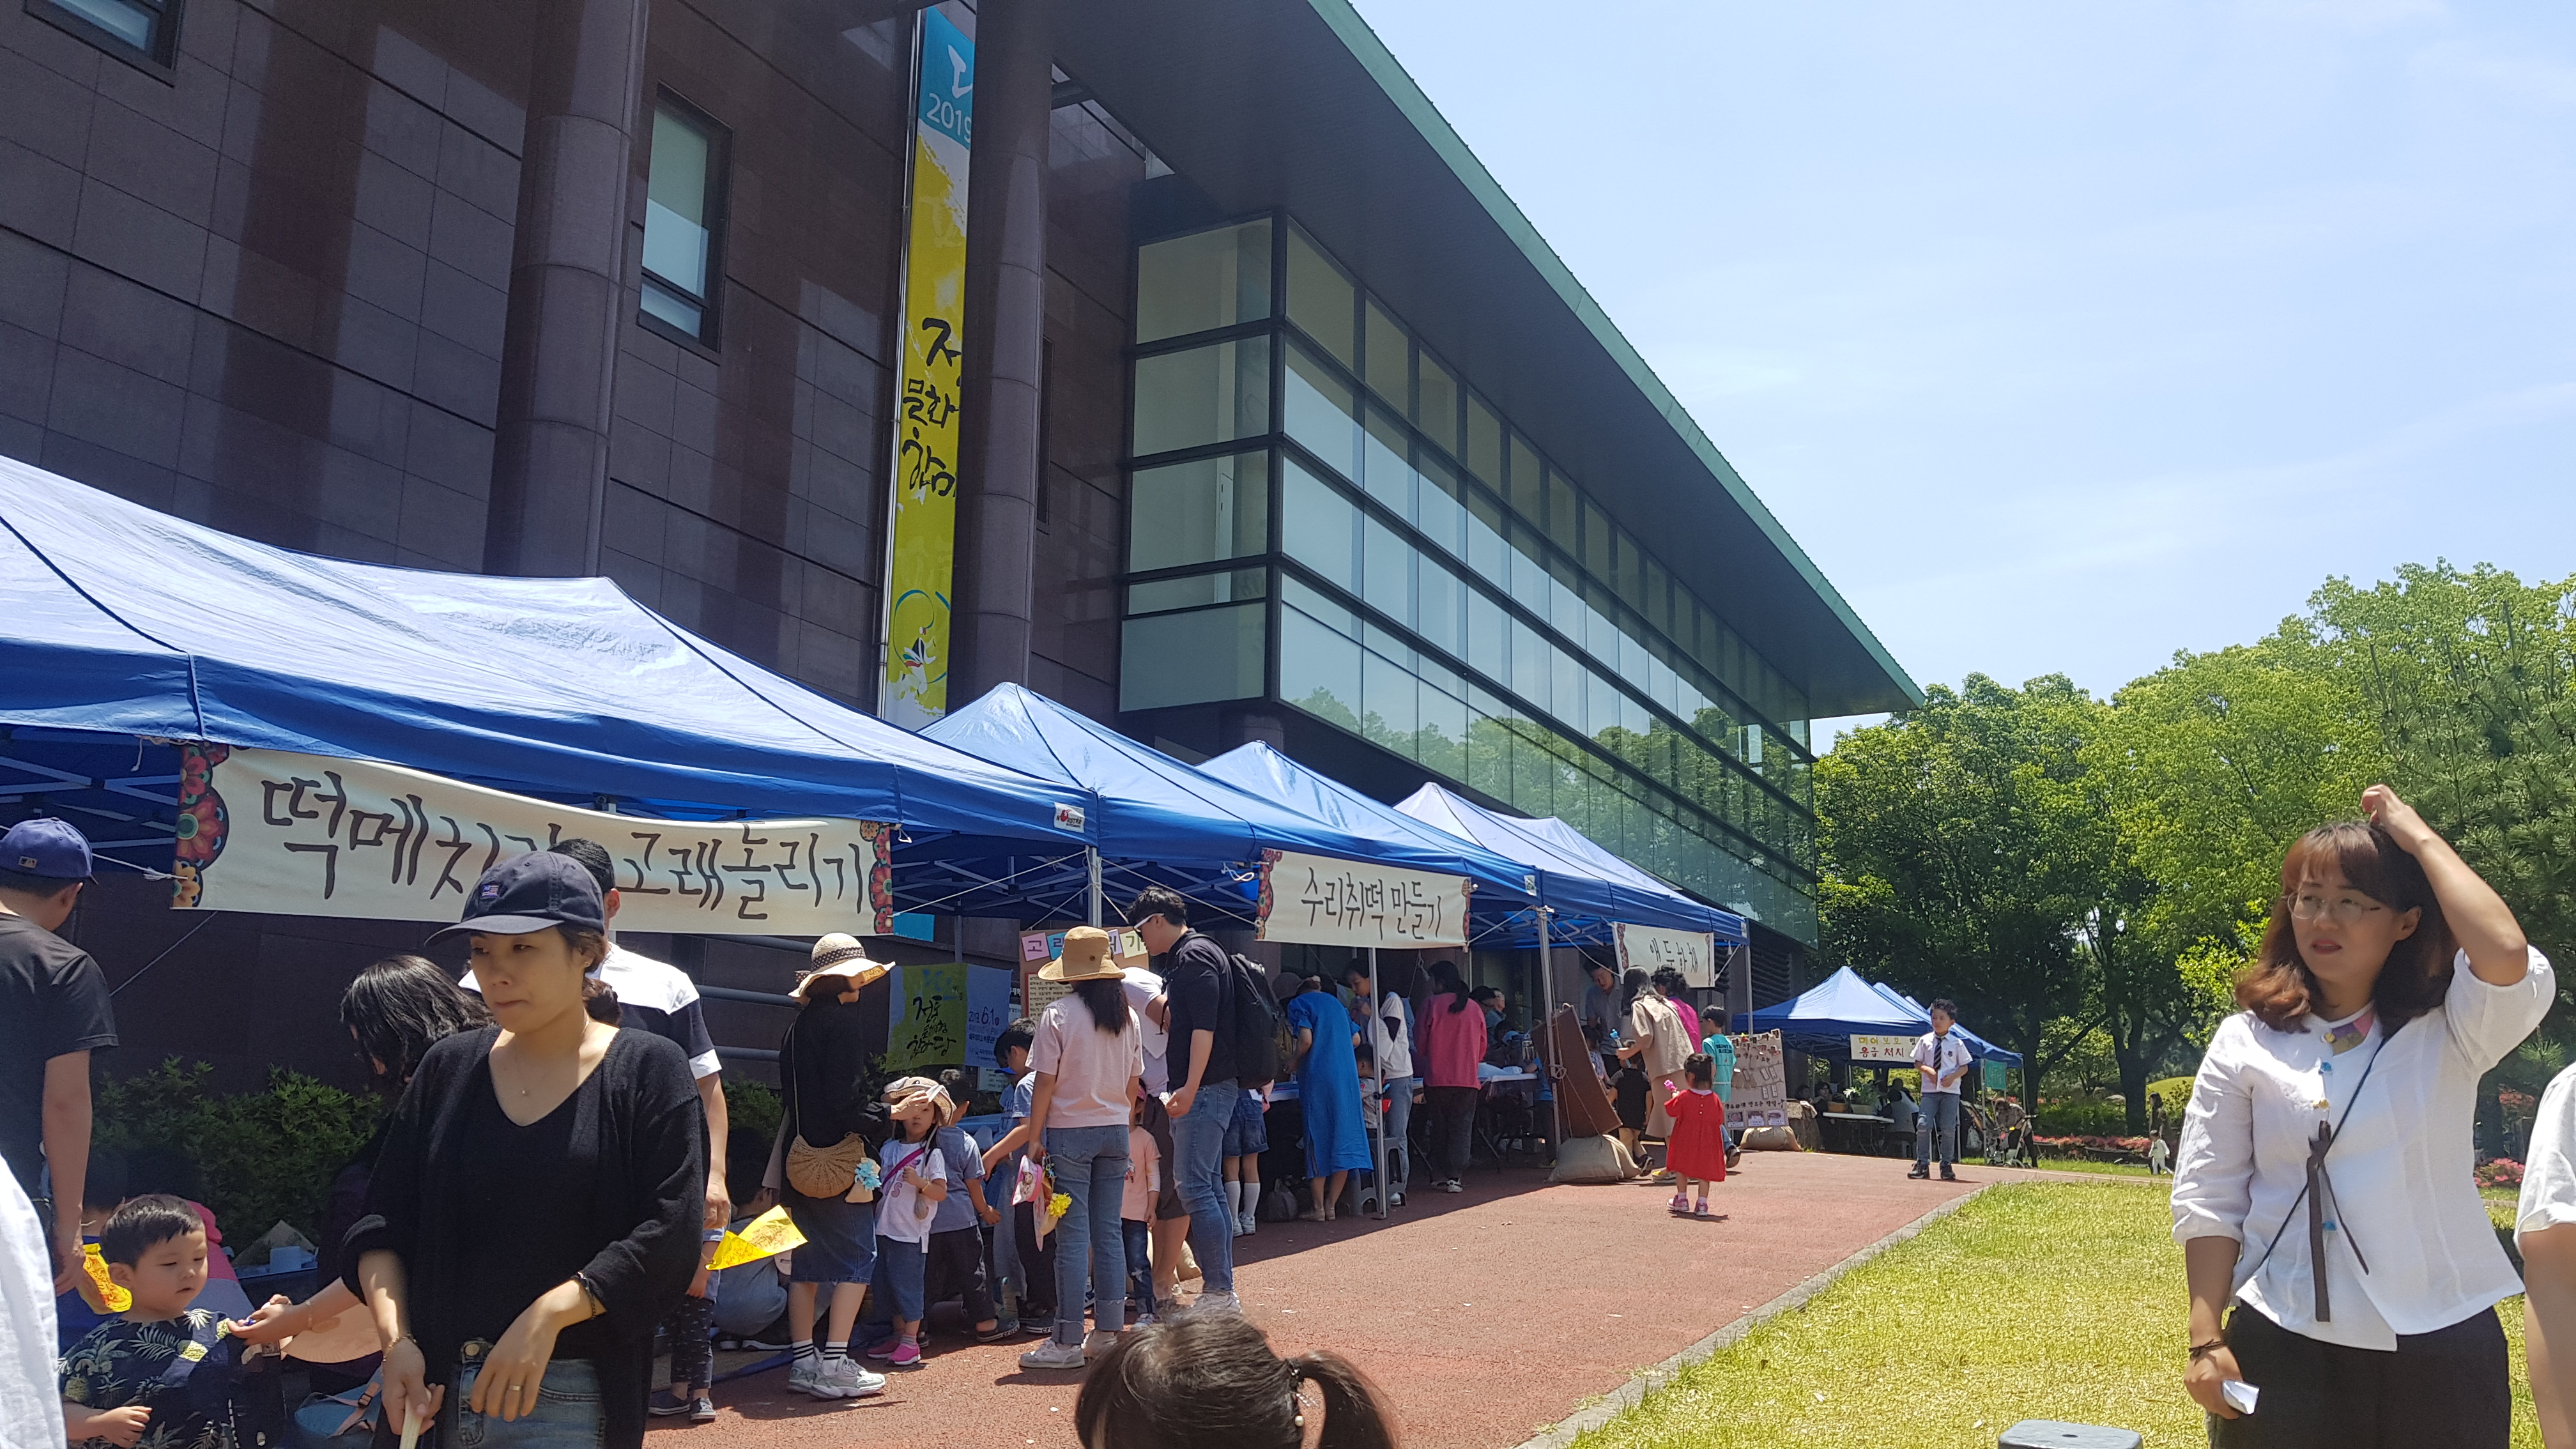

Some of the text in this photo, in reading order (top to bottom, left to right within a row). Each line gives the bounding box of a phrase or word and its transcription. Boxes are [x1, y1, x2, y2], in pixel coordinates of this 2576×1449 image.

[261, 770, 562, 900] 떡메치
[1301, 866, 1441, 941] 수리취떡 만들기
[1859, 1037, 1878, 1045] 미아
[1883, 1036, 1902, 1045] 보호
[1859, 1046, 1879, 1058] 응급
